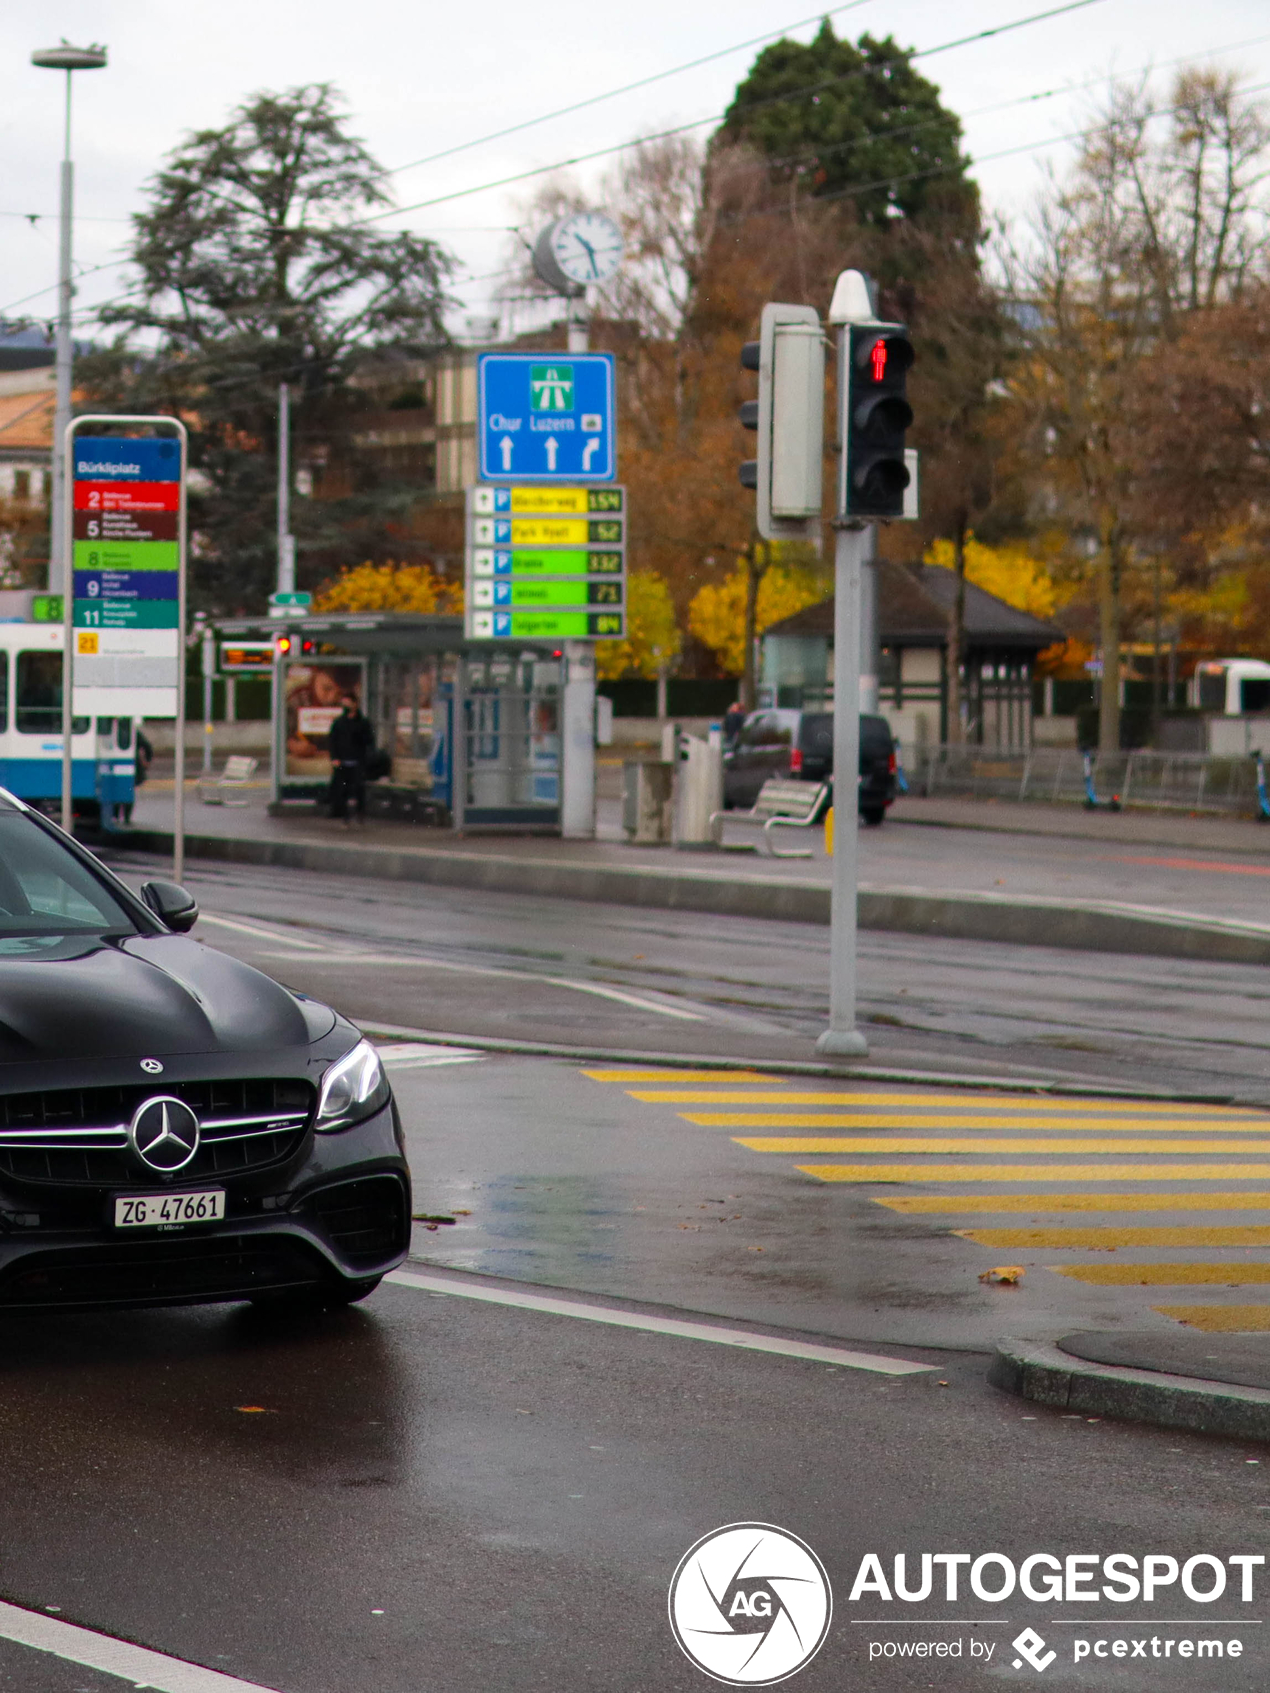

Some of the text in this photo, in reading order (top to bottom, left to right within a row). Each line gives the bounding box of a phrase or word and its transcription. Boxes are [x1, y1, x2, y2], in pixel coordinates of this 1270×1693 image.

[489, 413, 575, 431] Chur Luzern
[77, 461, 140, 474] Bürkliplatz
[88, 491, 100, 507] 2
[87, 521, 100, 536] 5
[88, 552, 99, 566] 8
[87, 581, 99, 597] 9
[83, 611, 99, 625] 11
[80, 637, 95, 650] 21
[160, 1195, 217, 1221] 47661
